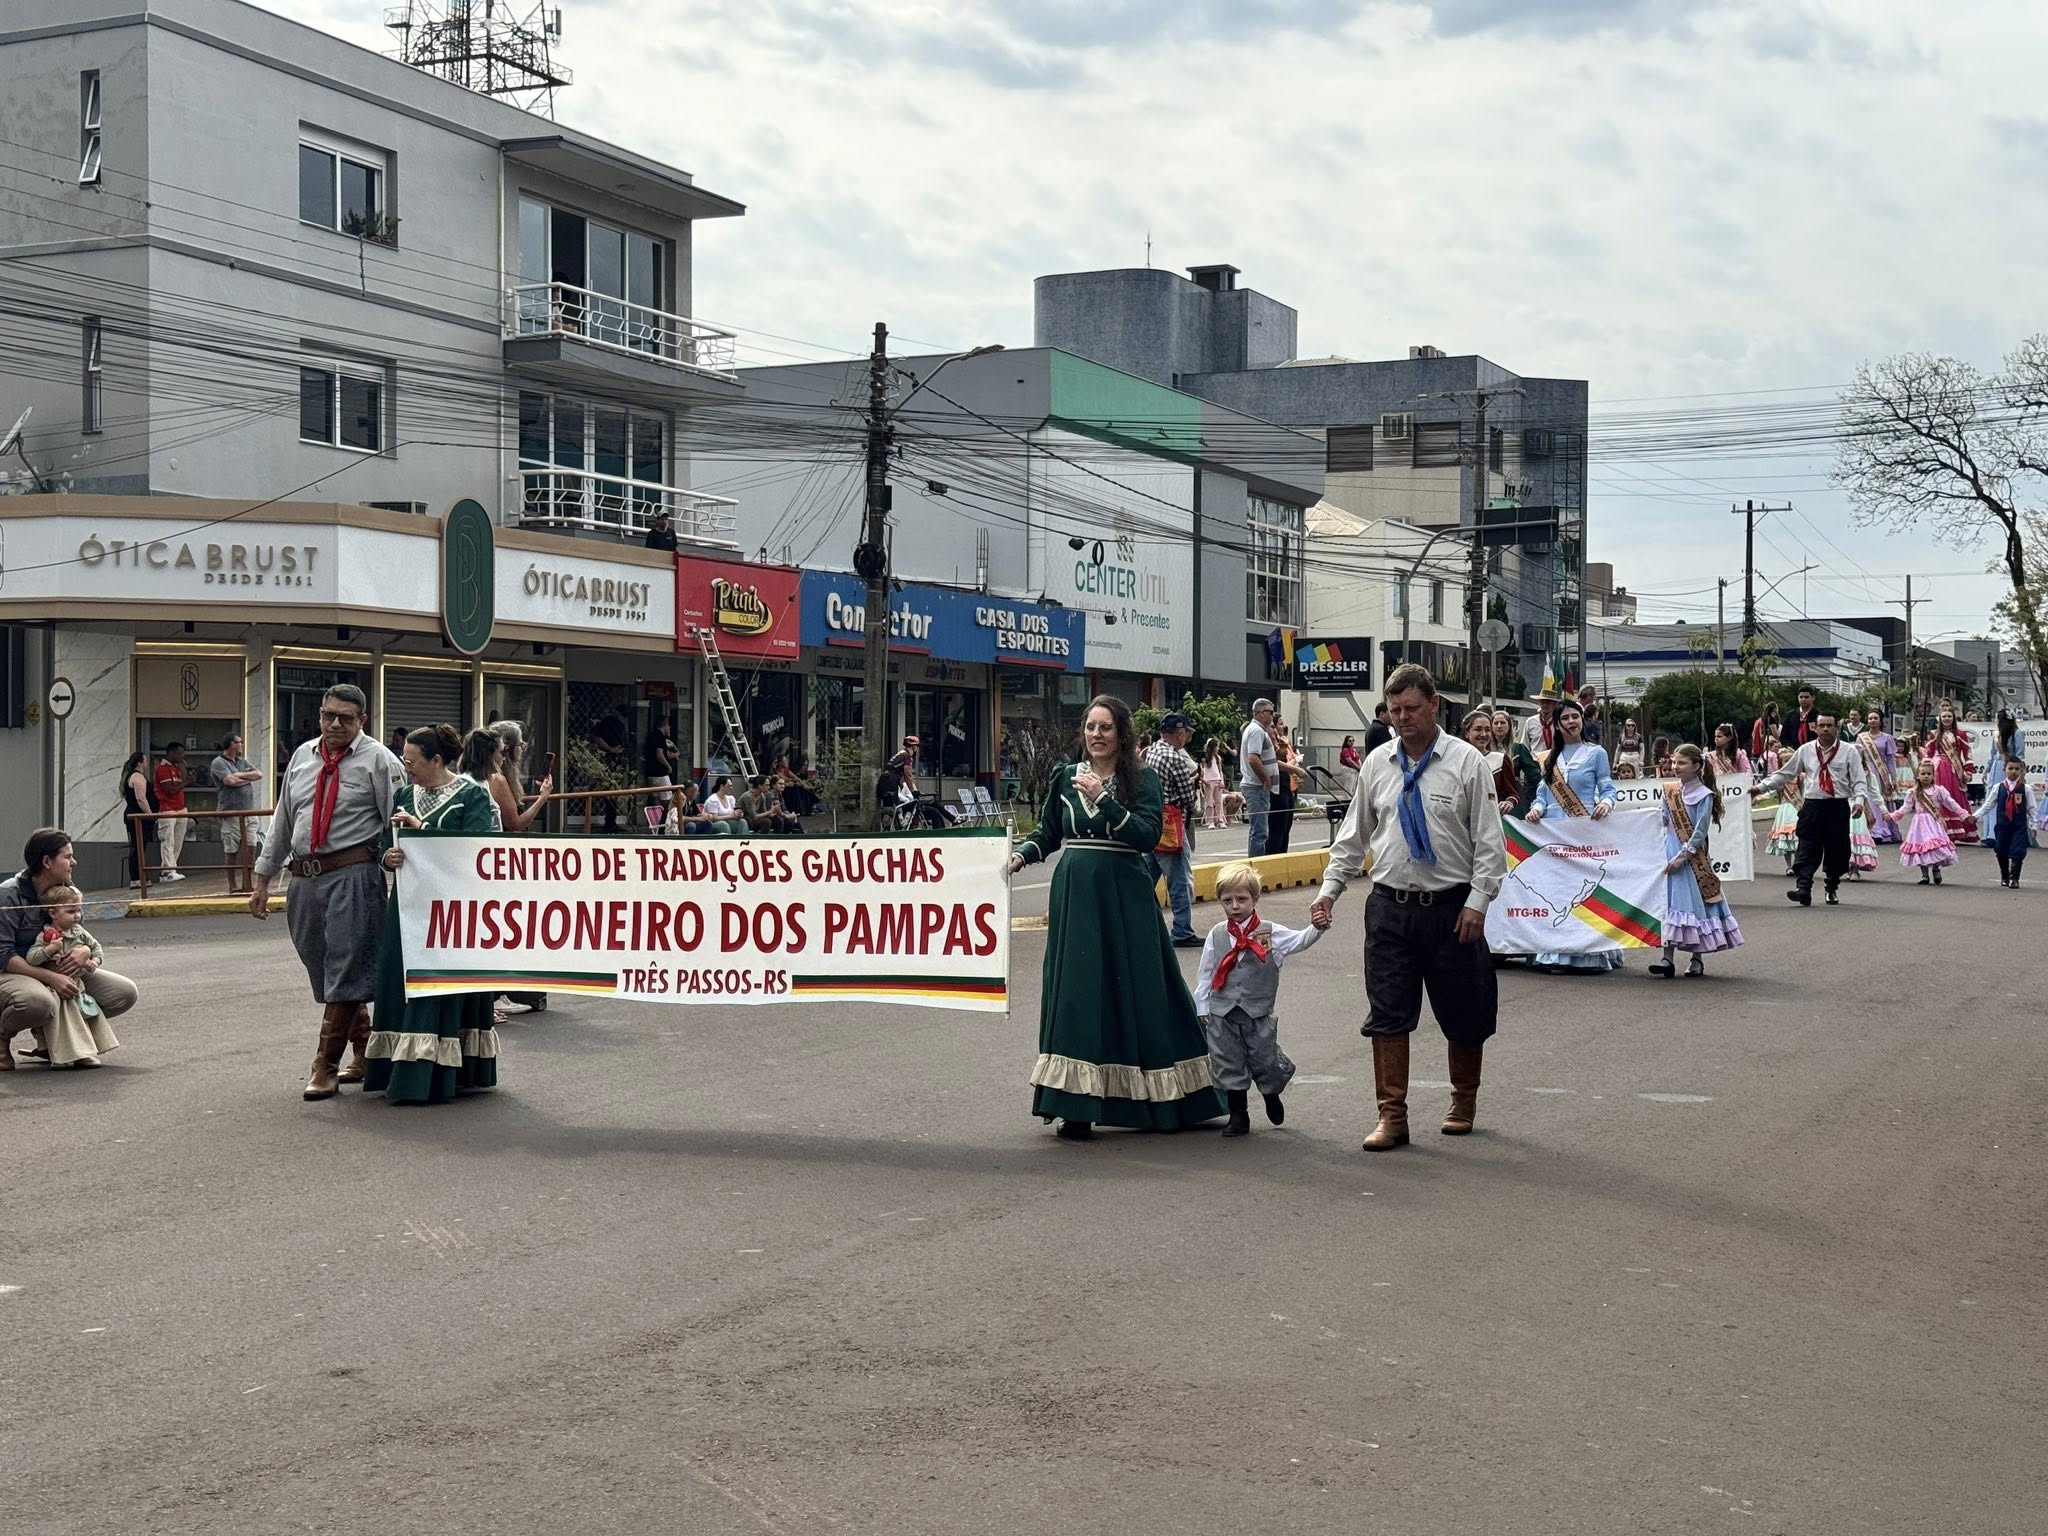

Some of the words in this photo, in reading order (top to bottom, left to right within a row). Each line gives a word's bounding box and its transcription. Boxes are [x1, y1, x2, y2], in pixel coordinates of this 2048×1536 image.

[204, 573, 264, 586] DESDE
[275, 575, 314, 587] 1951
[1075, 561, 1136, 599] CENTER
[1140, 565, 1170, 605] ÚTIL
[712, 578, 760, 611] Print
[589, 606, 622, 619] DESDE
[625, 610, 647, 621] 1951
[738, 614, 760, 625] COLOR
[826, 592, 933, 640] Conctor
[975, 607, 1016, 631] CASA
[1021, 613, 1049, 634] DOS
[1121, 607, 1128, 624] &
[1131, 609, 1171, 630] Presentes
[996, 630, 1070, 656] ESPORTES
[1299, 661, 1368, 673] DRESSLER
[1616, 788, 1648, 802] CTG
[1551, 849, 1620, 858] TRADICIONALISTA
[476, 847, 582, 881] CENTRO
[593, 848, 627, 881] DE
[636, 841, 793, 893] TRADIÇÕES
[801, 841, 945, 883] GAÚCHAS
[1507, 907, 1549, 918] MTG-RS
[426, 900, 705, 952] MISSIONEIRO
[720, 902, 807, 953] DOS
[823, 902, 997, 956] PAMPAS
[622, 961, 669, 994] TRÊS
[676, 968, 788, 995] PASSOS-RS
